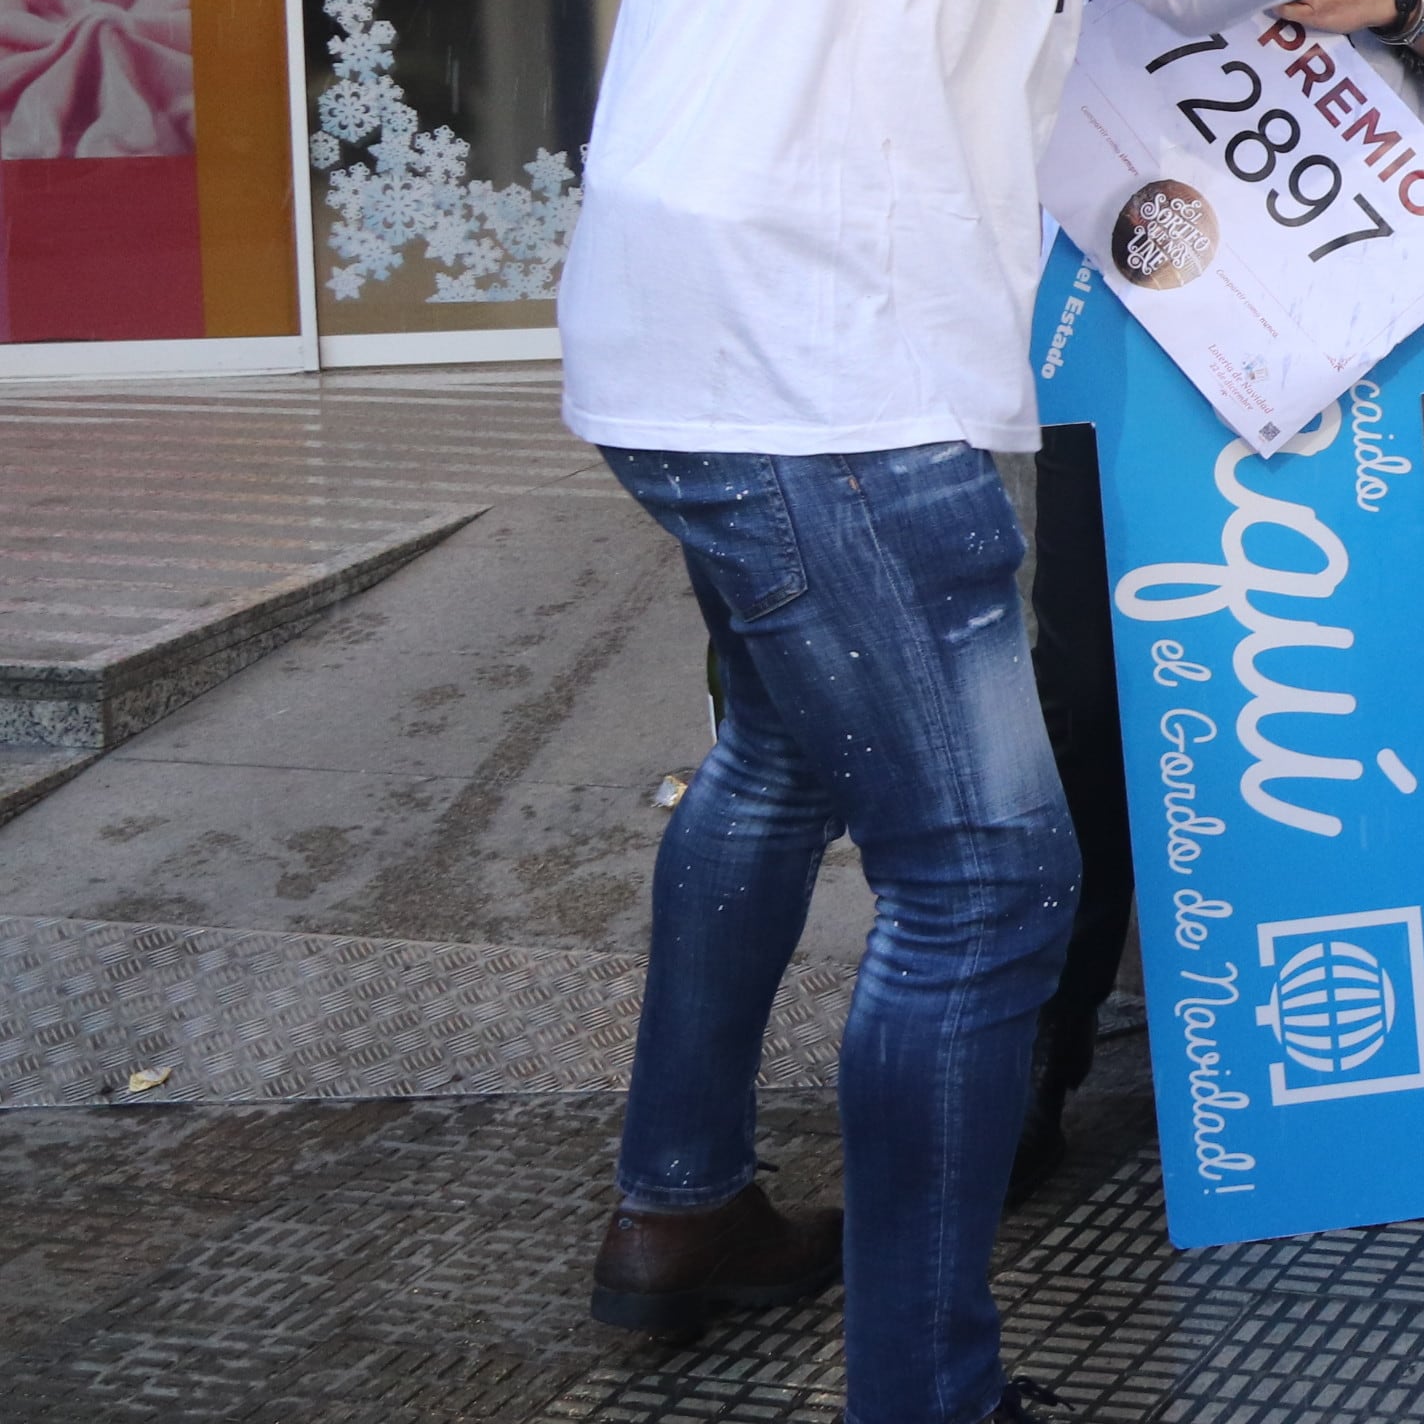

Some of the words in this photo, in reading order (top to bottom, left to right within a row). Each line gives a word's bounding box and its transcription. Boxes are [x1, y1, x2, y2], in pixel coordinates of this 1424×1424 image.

[1127, 225, 1168, 275] UNE
[1140, 192, 1210, 252] SORTEO
[1041, 295, 1085, 379] Estado
[1241, 378, 1275, 415] Navidad
[1151, 639, 1212, 687] el
[1159, 708, 1226, 875] Gordo
[1173, 887, 1233, 951] de
[1174, 962, 1256, 1196] Navidad!
